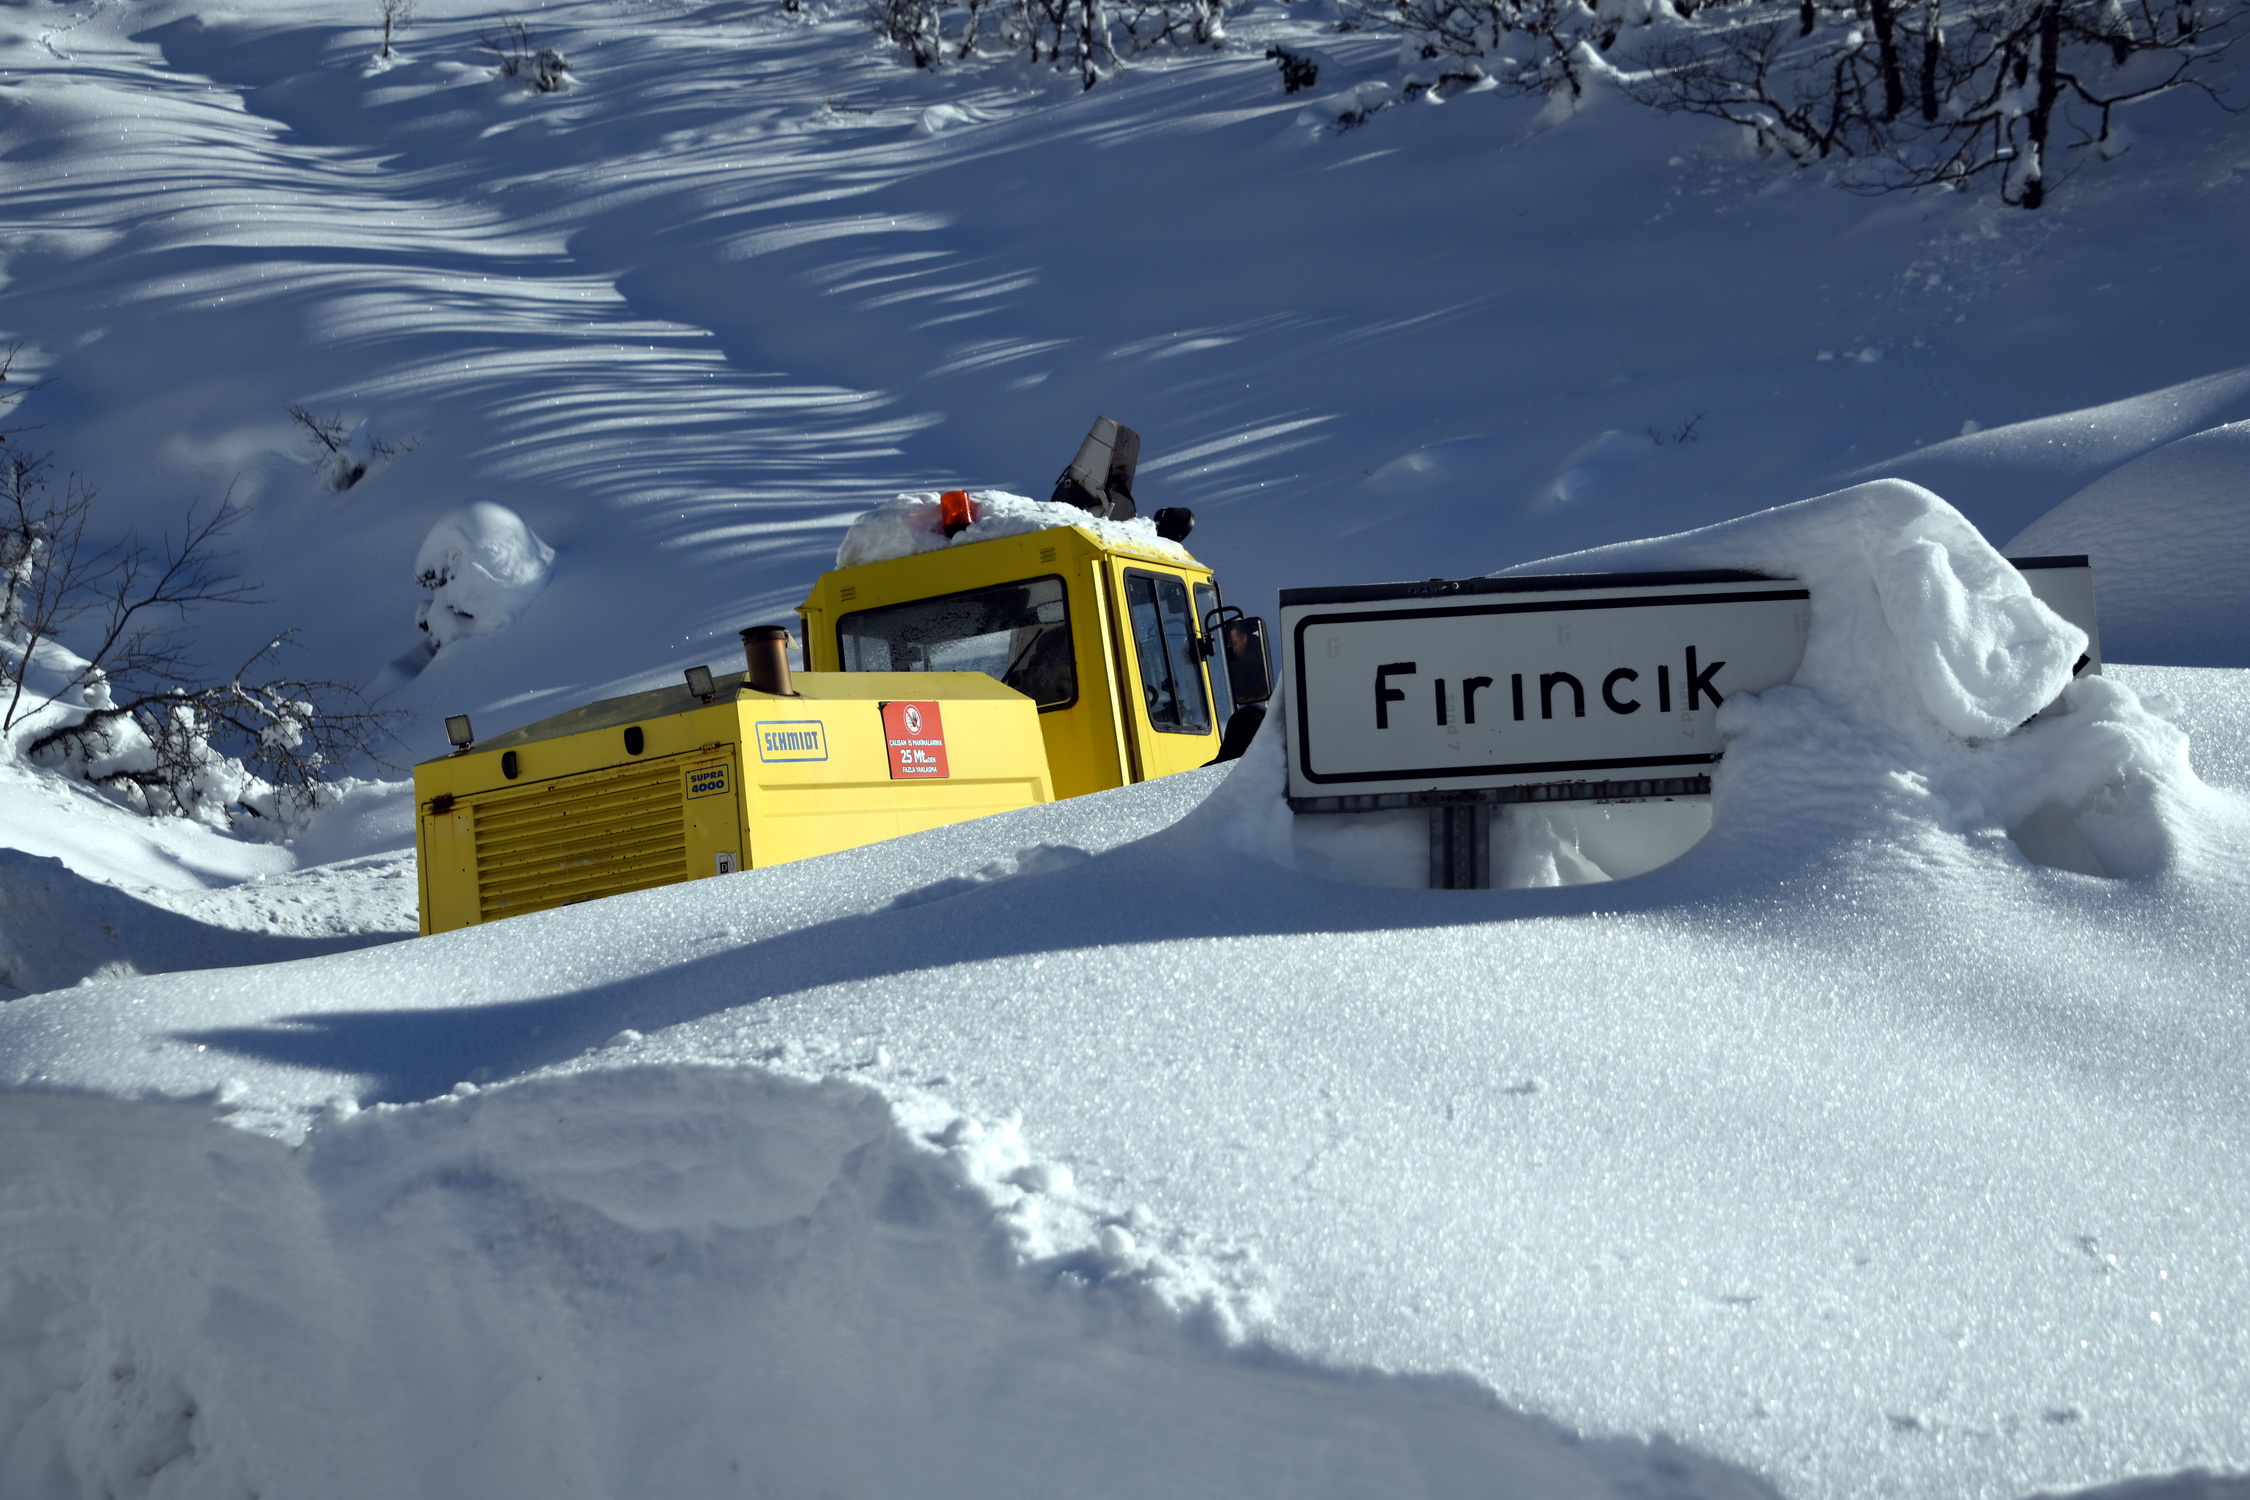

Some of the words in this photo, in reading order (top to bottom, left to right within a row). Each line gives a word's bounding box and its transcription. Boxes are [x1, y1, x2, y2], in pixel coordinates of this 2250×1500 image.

[1375, 645, 1726, 730] Fırıncık
[764, 731, 819, 751] SCHMIDT
[900, 749, 913, 764] 25
[691, 770, 724, 783] SUPRA
[692, 780, 725, 793] 4000
[721, 863, 728, 872] D
